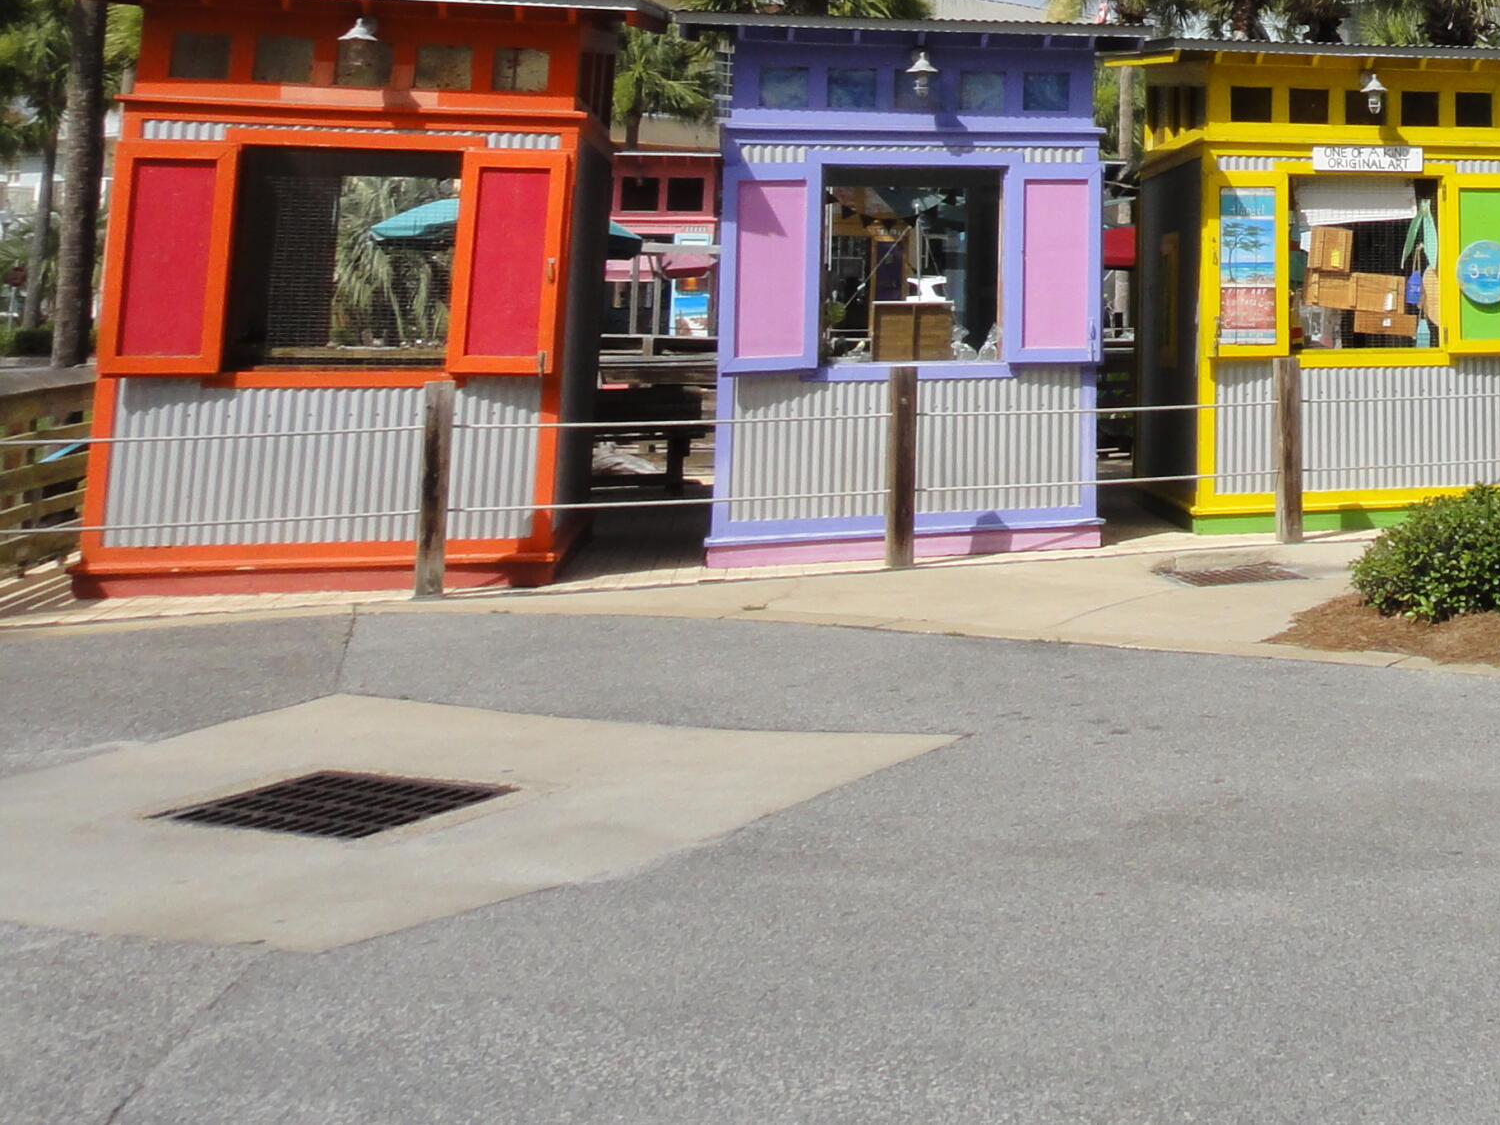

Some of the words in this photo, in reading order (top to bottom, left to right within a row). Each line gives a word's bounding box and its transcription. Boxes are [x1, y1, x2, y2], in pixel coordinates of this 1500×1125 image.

[1324, 146, 1347, 158] ONE
[1351, 146, 1364, 158] OF
[1370, 146, 1379, 157] A
[1383, 146, 1410, 158] KIND
[1328, 158, 1385, 170] ORIGINAL
[1388, 158, 1410, 171] ART
